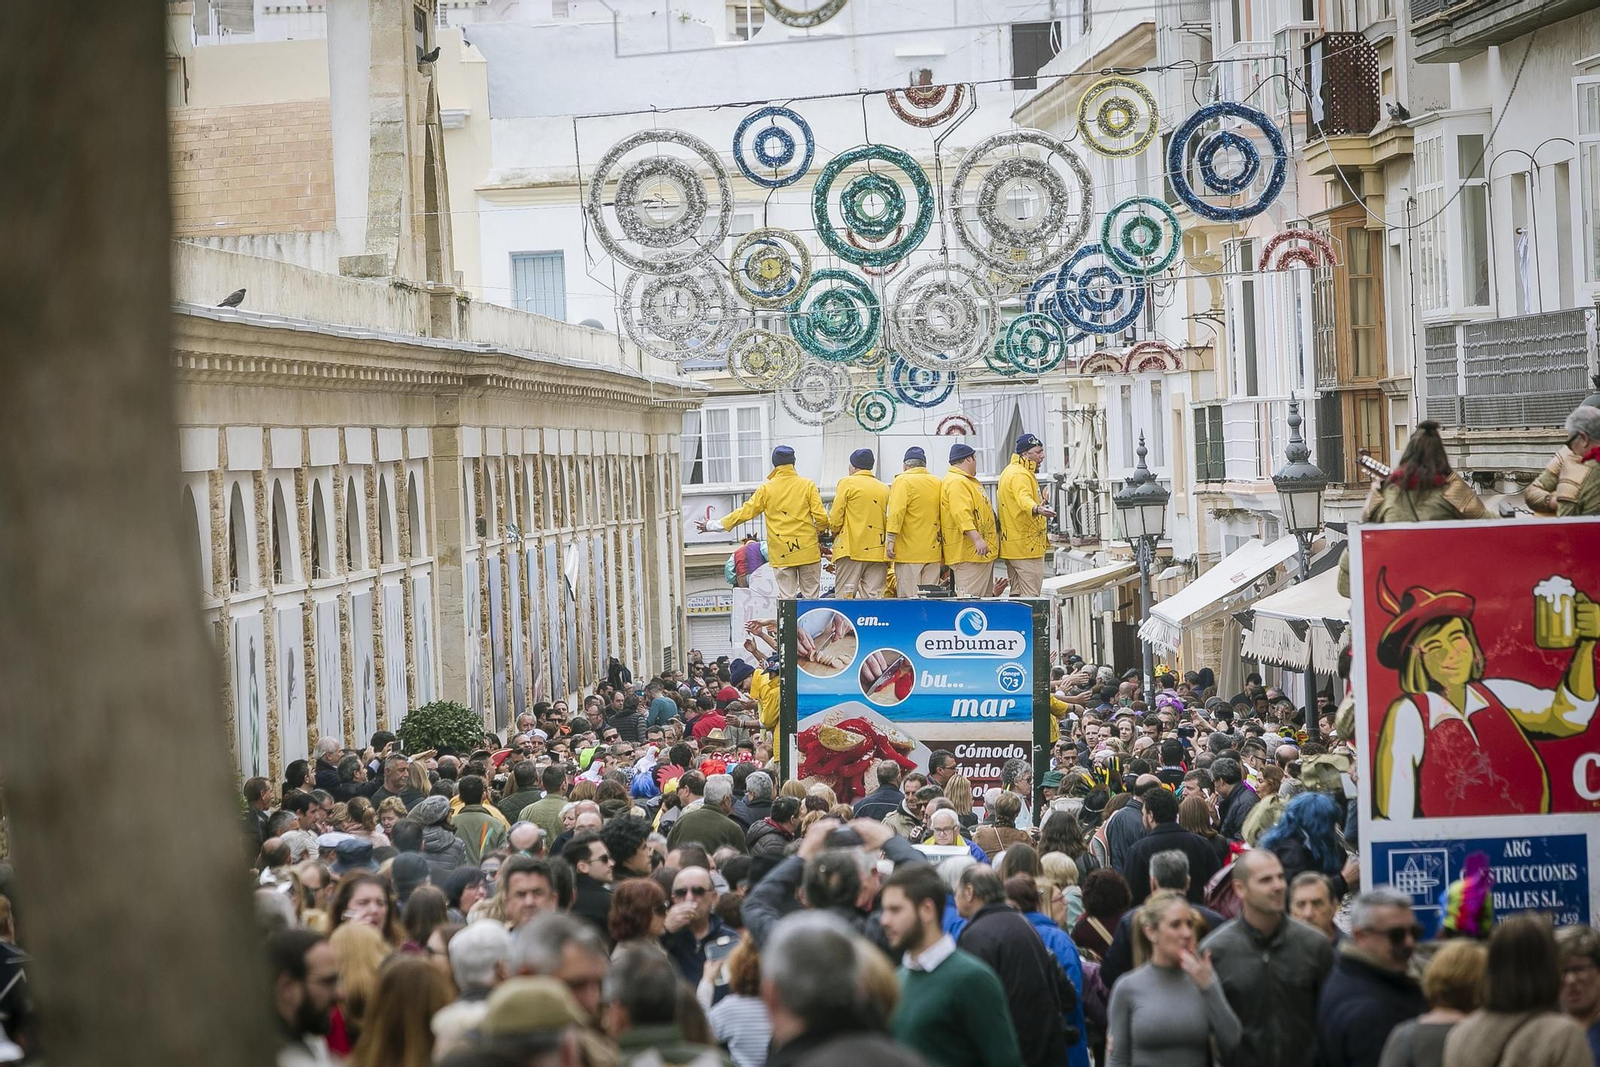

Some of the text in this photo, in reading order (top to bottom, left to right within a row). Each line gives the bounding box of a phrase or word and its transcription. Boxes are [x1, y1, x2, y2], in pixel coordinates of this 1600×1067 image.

[856, 615, 890, 627] em...
[924, 635, 1018, 651] embumar
[920, 670, 964, 688] bu...
[1012, 678, 1019, 688] 3
[950, 698, 1016, 718] mar
[954, 743, 1028, 760] Cómodo,
[1572, 752, 1600, 801] C
[1503, 839, 1532, 858] ARG
[1493, 890, 1539, 909] BIALES
